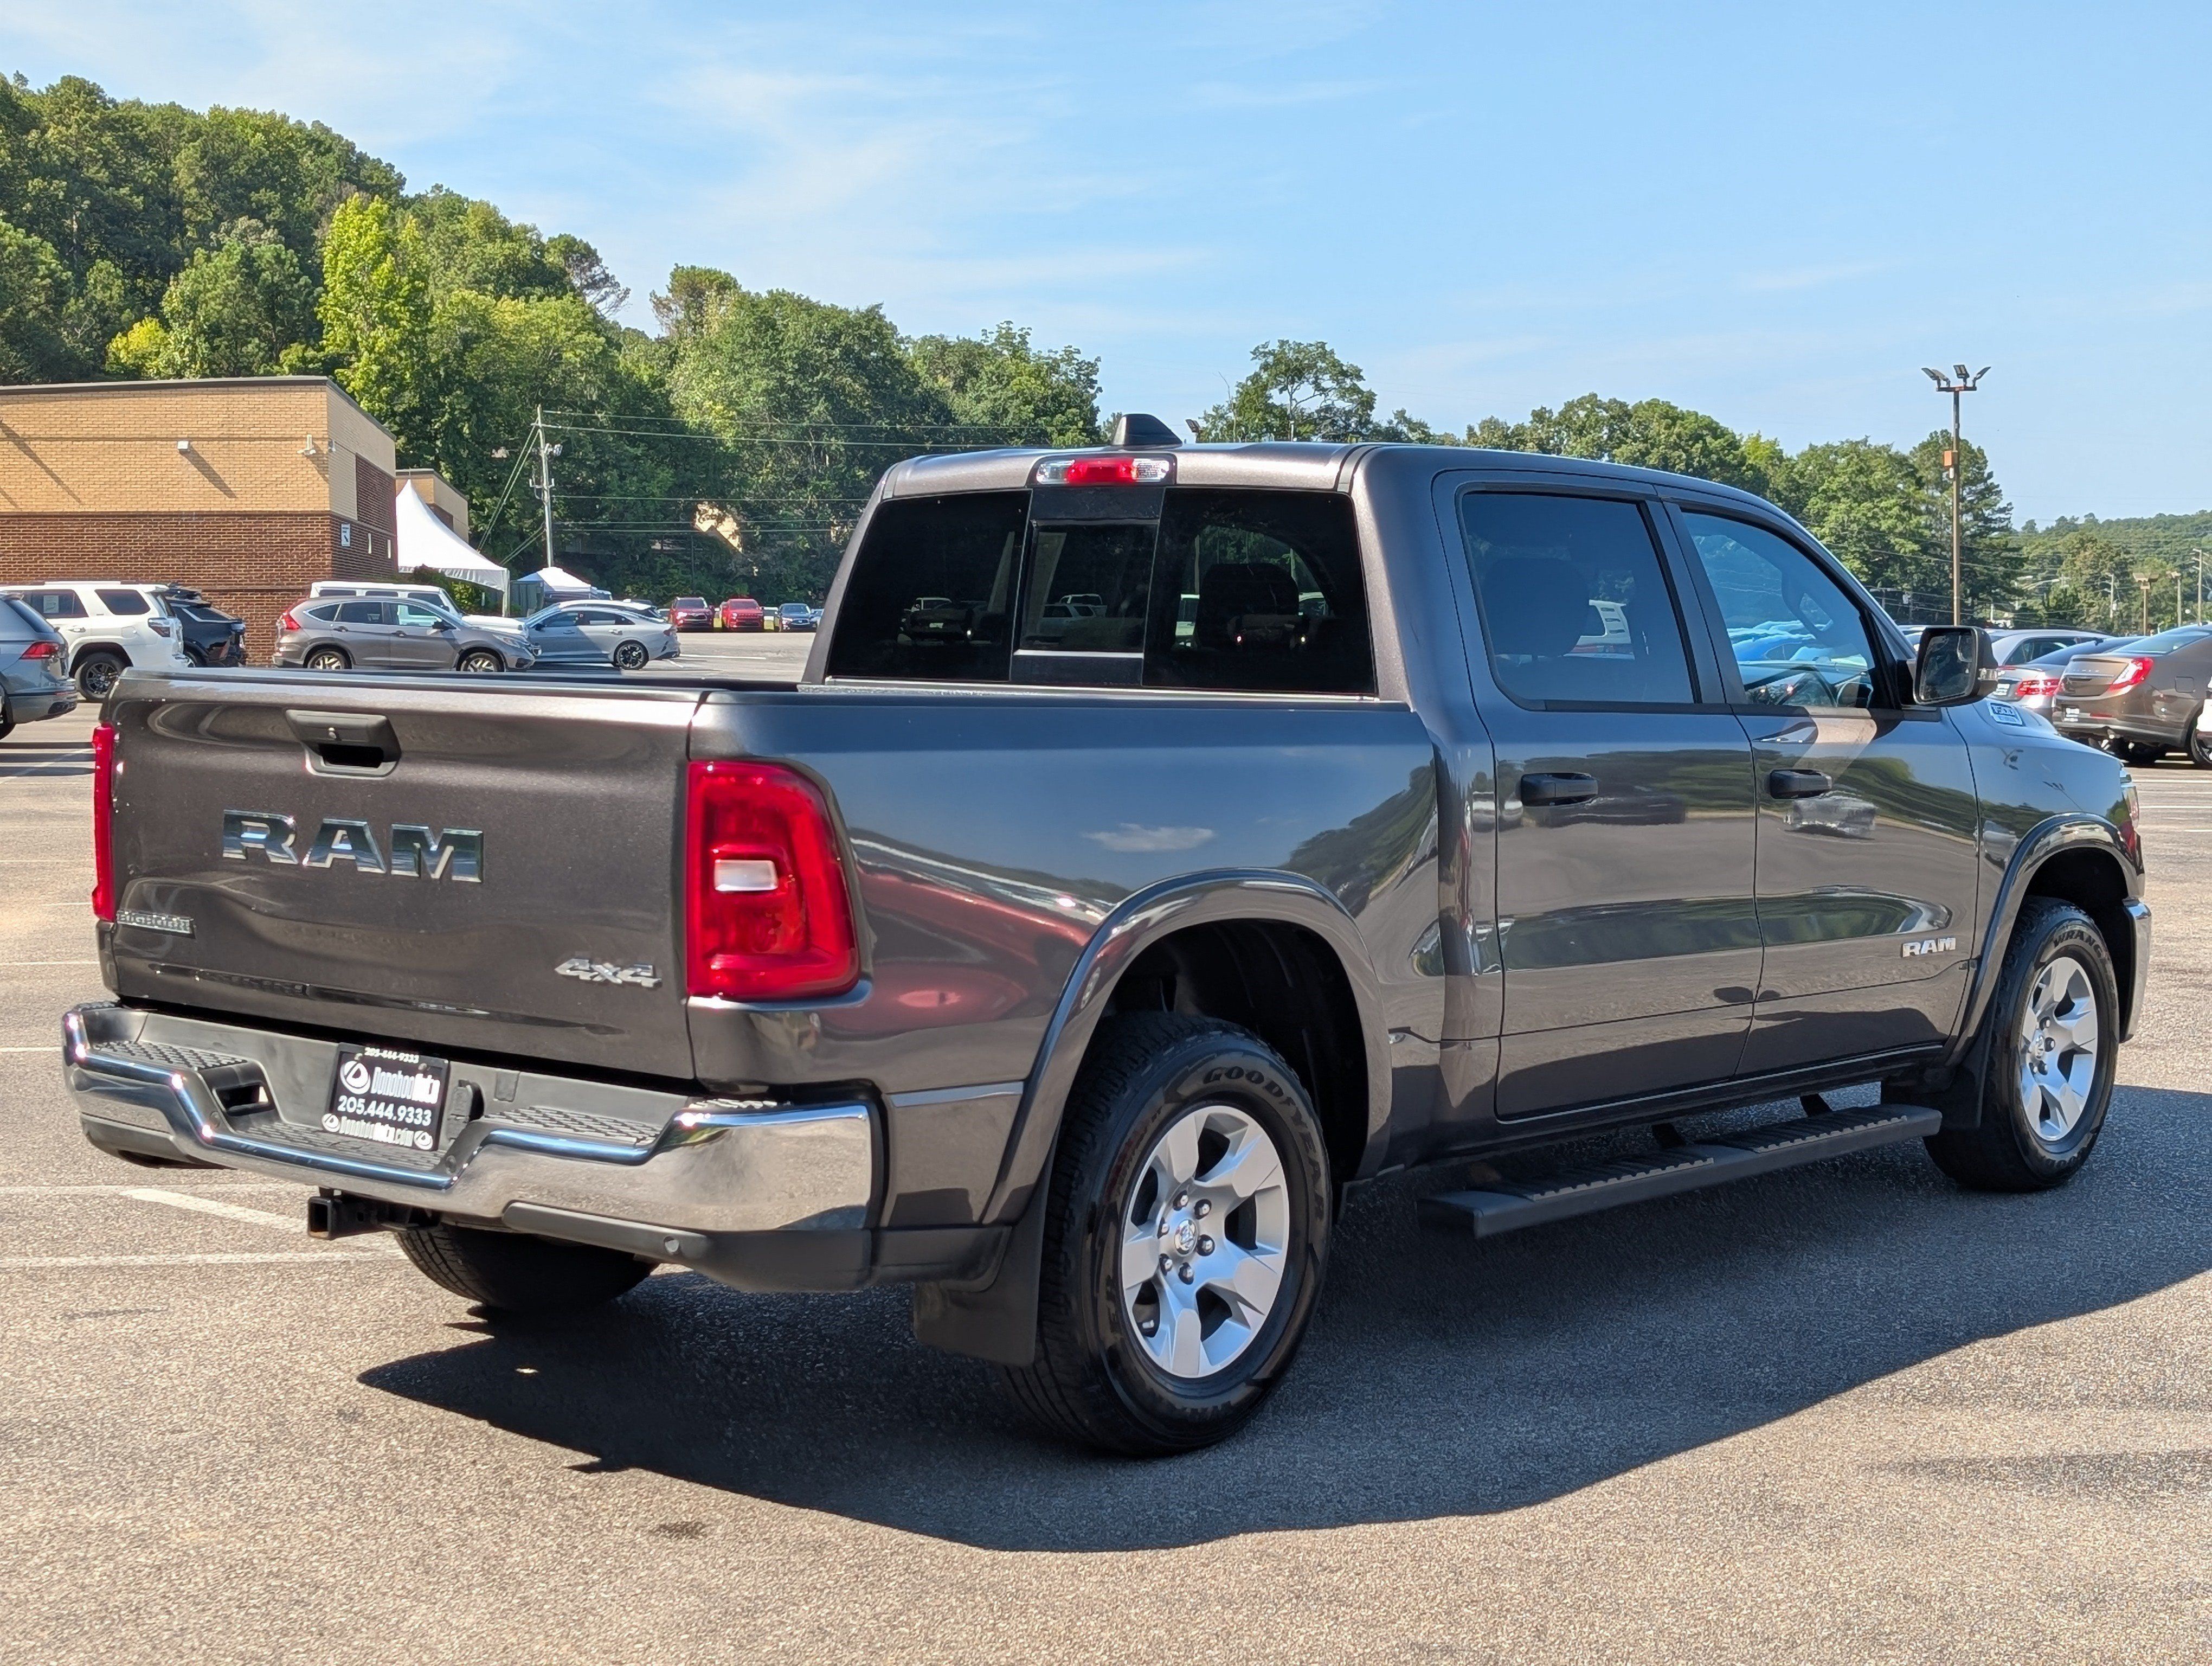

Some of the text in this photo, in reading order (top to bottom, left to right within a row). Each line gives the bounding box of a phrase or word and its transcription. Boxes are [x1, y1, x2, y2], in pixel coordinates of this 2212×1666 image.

[223, 810, 484, 883] RAM
[1902, 937, 1956, 958] RAM
[337, 1095, 432, 1126] 205.444.9333
[1203, 1066, 1324, 1221] GOODYEAR
